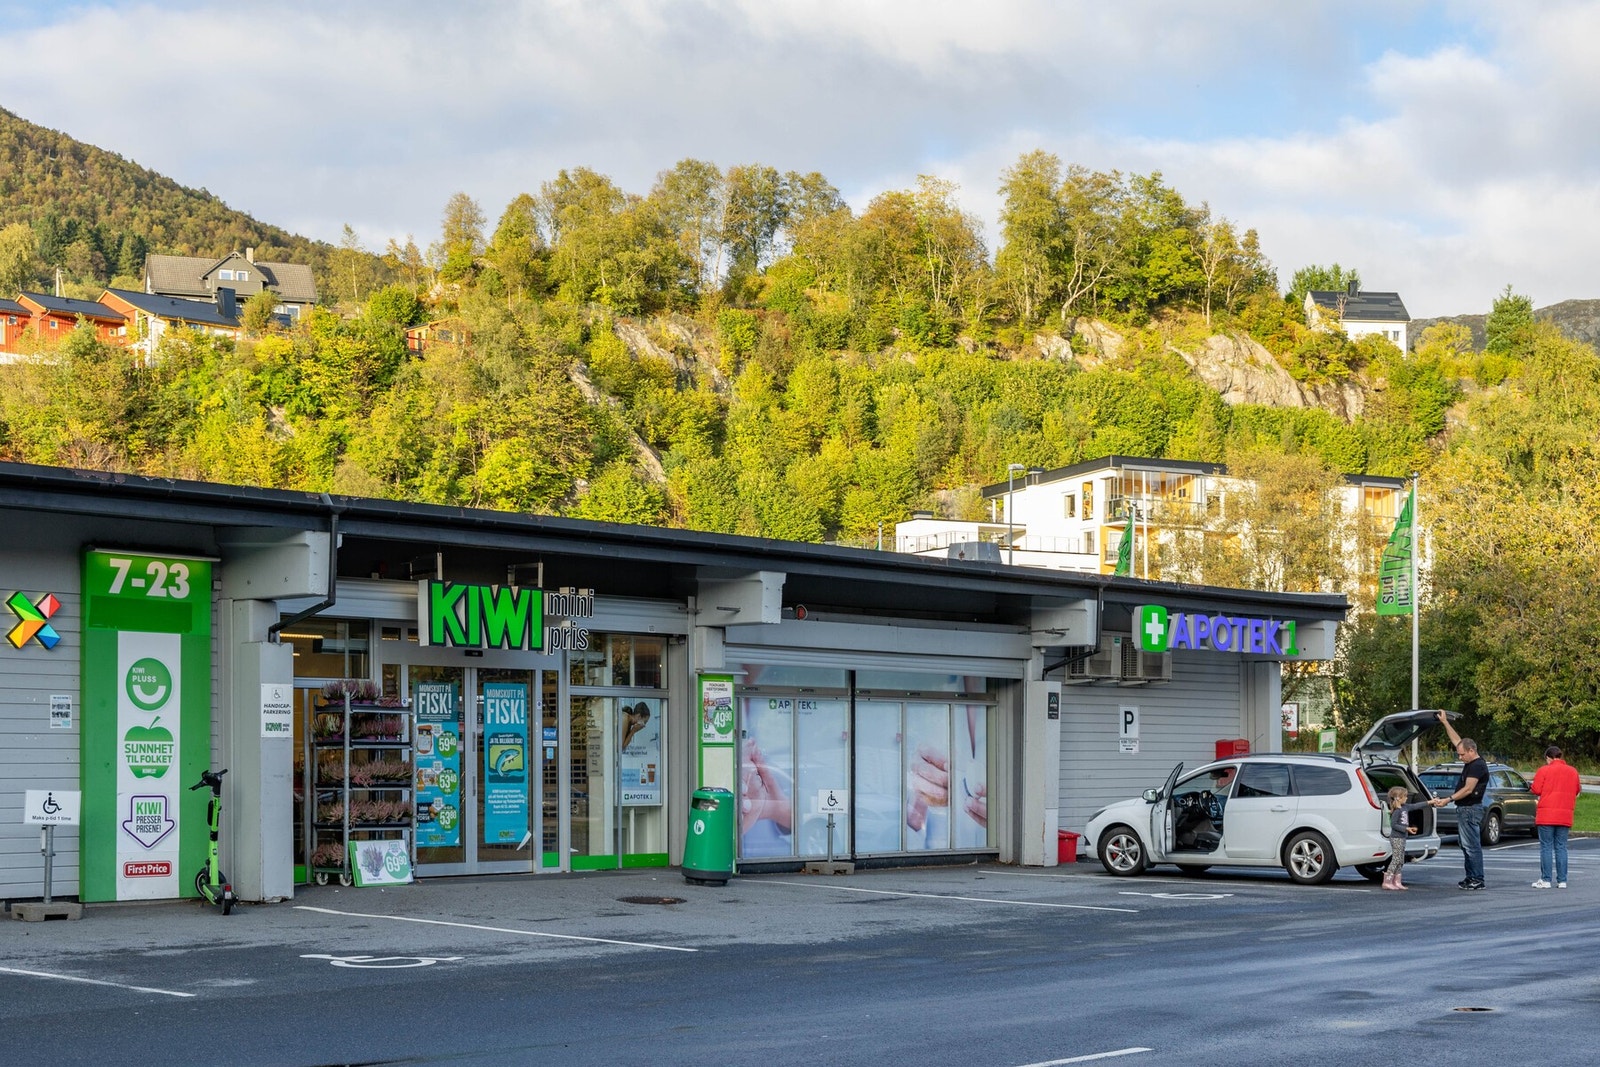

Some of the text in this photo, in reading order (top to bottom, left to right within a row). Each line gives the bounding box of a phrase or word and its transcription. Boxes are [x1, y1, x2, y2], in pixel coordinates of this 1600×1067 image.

[108, 558, 190, 599] 7-23
[1381, 575, 1395, 605] pris
[549, 586, 595, 619] mini
[430, 580, 544, 650] KIWI
[549, 620, 589, 656] pris
[1171, 612, 1300, 656] APOTEK 1
[132, 675, 157, 683] PLUSS
[419, 684, 445, 692] MOMSKUTT
[486, 687, 525, 699] MOMSKUTT PÅ
[419, 692, 452, 714] FISK!
[777, 700, 812, 710] APTEK
[486, 698, 525, 725] FISK!
[1124, 710, 1134, 734] P
[124, 743, 174, 754] SUNNHET
[126, 754, 173, 764] TIL FOLKET
[136, 802, 162, 815] KIWI
[136, 815, 162, 824] PRESSER
[136, 825, 162, 833] PRISENE!
[127, 864, 168, 874] First Price
